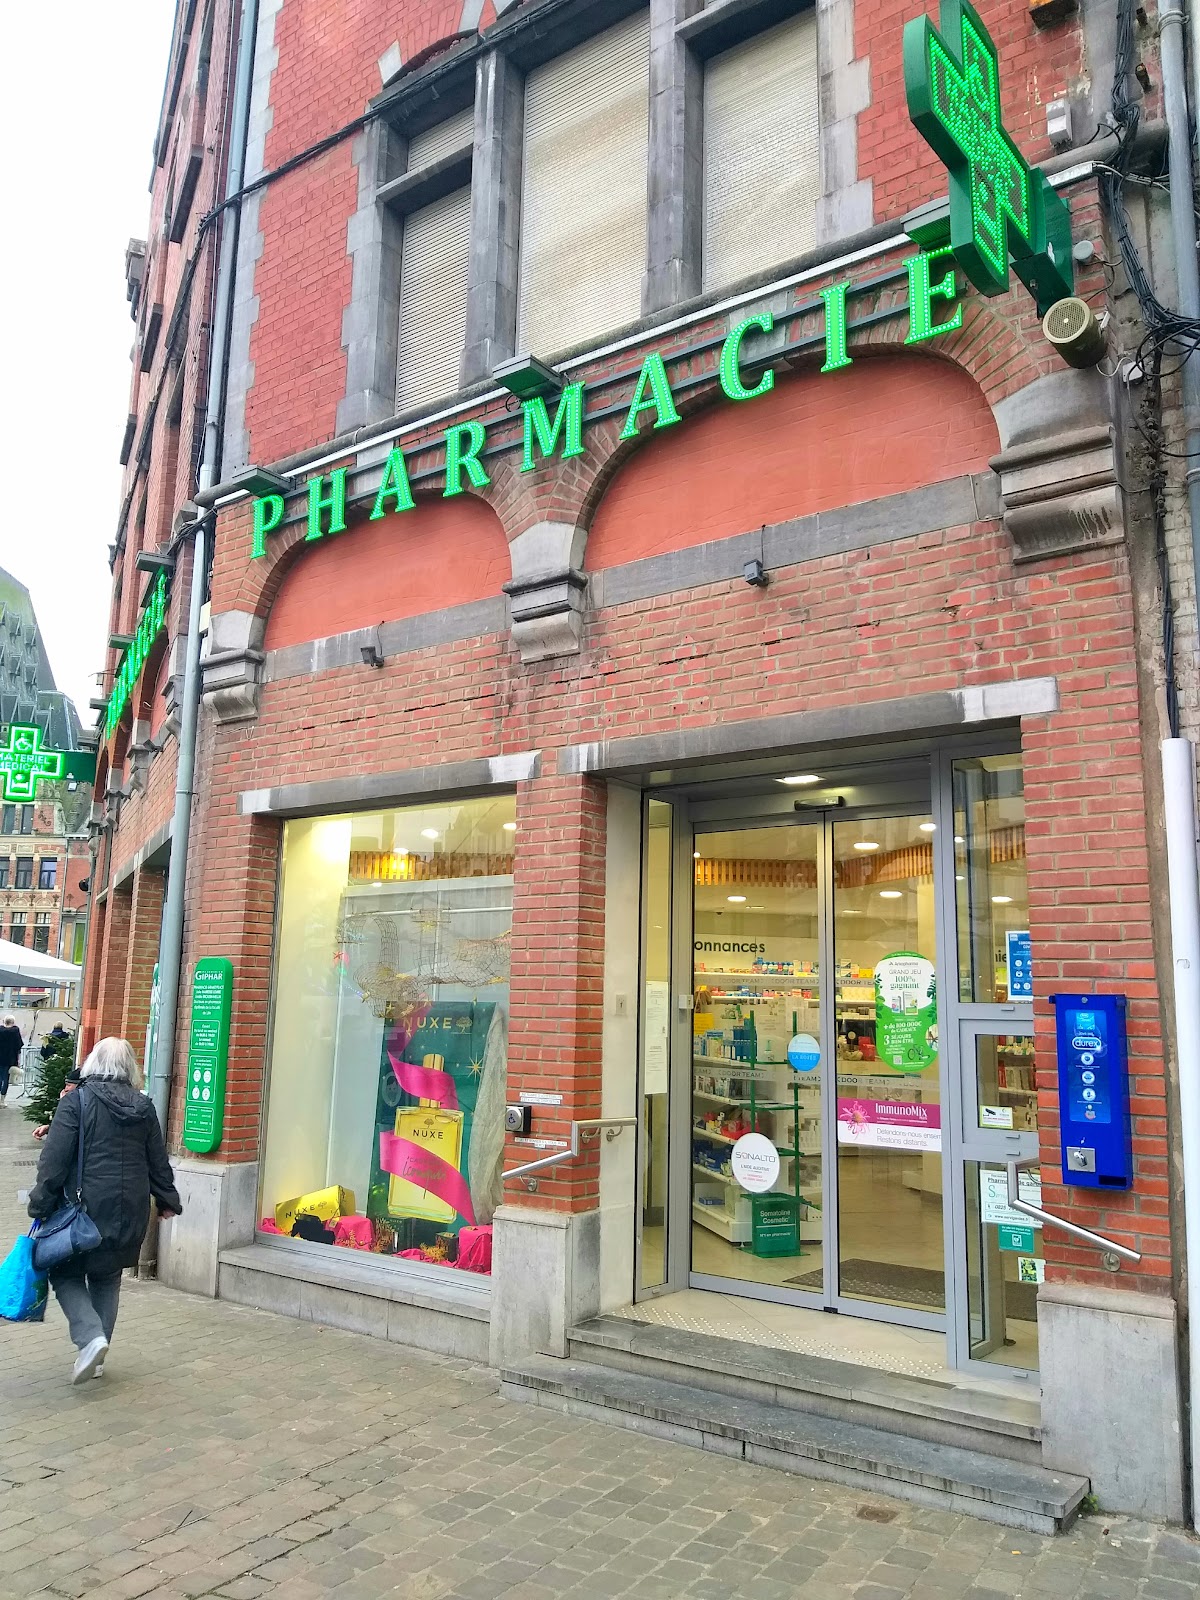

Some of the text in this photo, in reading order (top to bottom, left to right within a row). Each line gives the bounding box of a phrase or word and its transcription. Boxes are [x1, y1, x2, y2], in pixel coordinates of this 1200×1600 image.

[250, 245, 964, 559] PHARMACIE
[694, 940, 766, 954] onnances
[195, 970, 223, 981] GIPHAR
[895, 975, 916, 984] 100%
[403, 1016, 453, 1029] NUXE
[883, 1034, 890, 1046] 3
[1074, 1038, 1098, 1047] durex
[875, 1102, 928, 1117] ImmunoMix
[413, 1129, 444, 1140] NUXE
[877, 1135, 902, 1145] Restons
[923, 1132, 941, 1140] ensem
[735, 1151, 776, 1163] SONALTO
[988, 1177, 1008, 1185] Pharm
[285, 1204, 316, 1218] NUXE
[760, 1210, 791, 1218] Somatoline
[762, 1216, 789, 1224] Cosmetic
